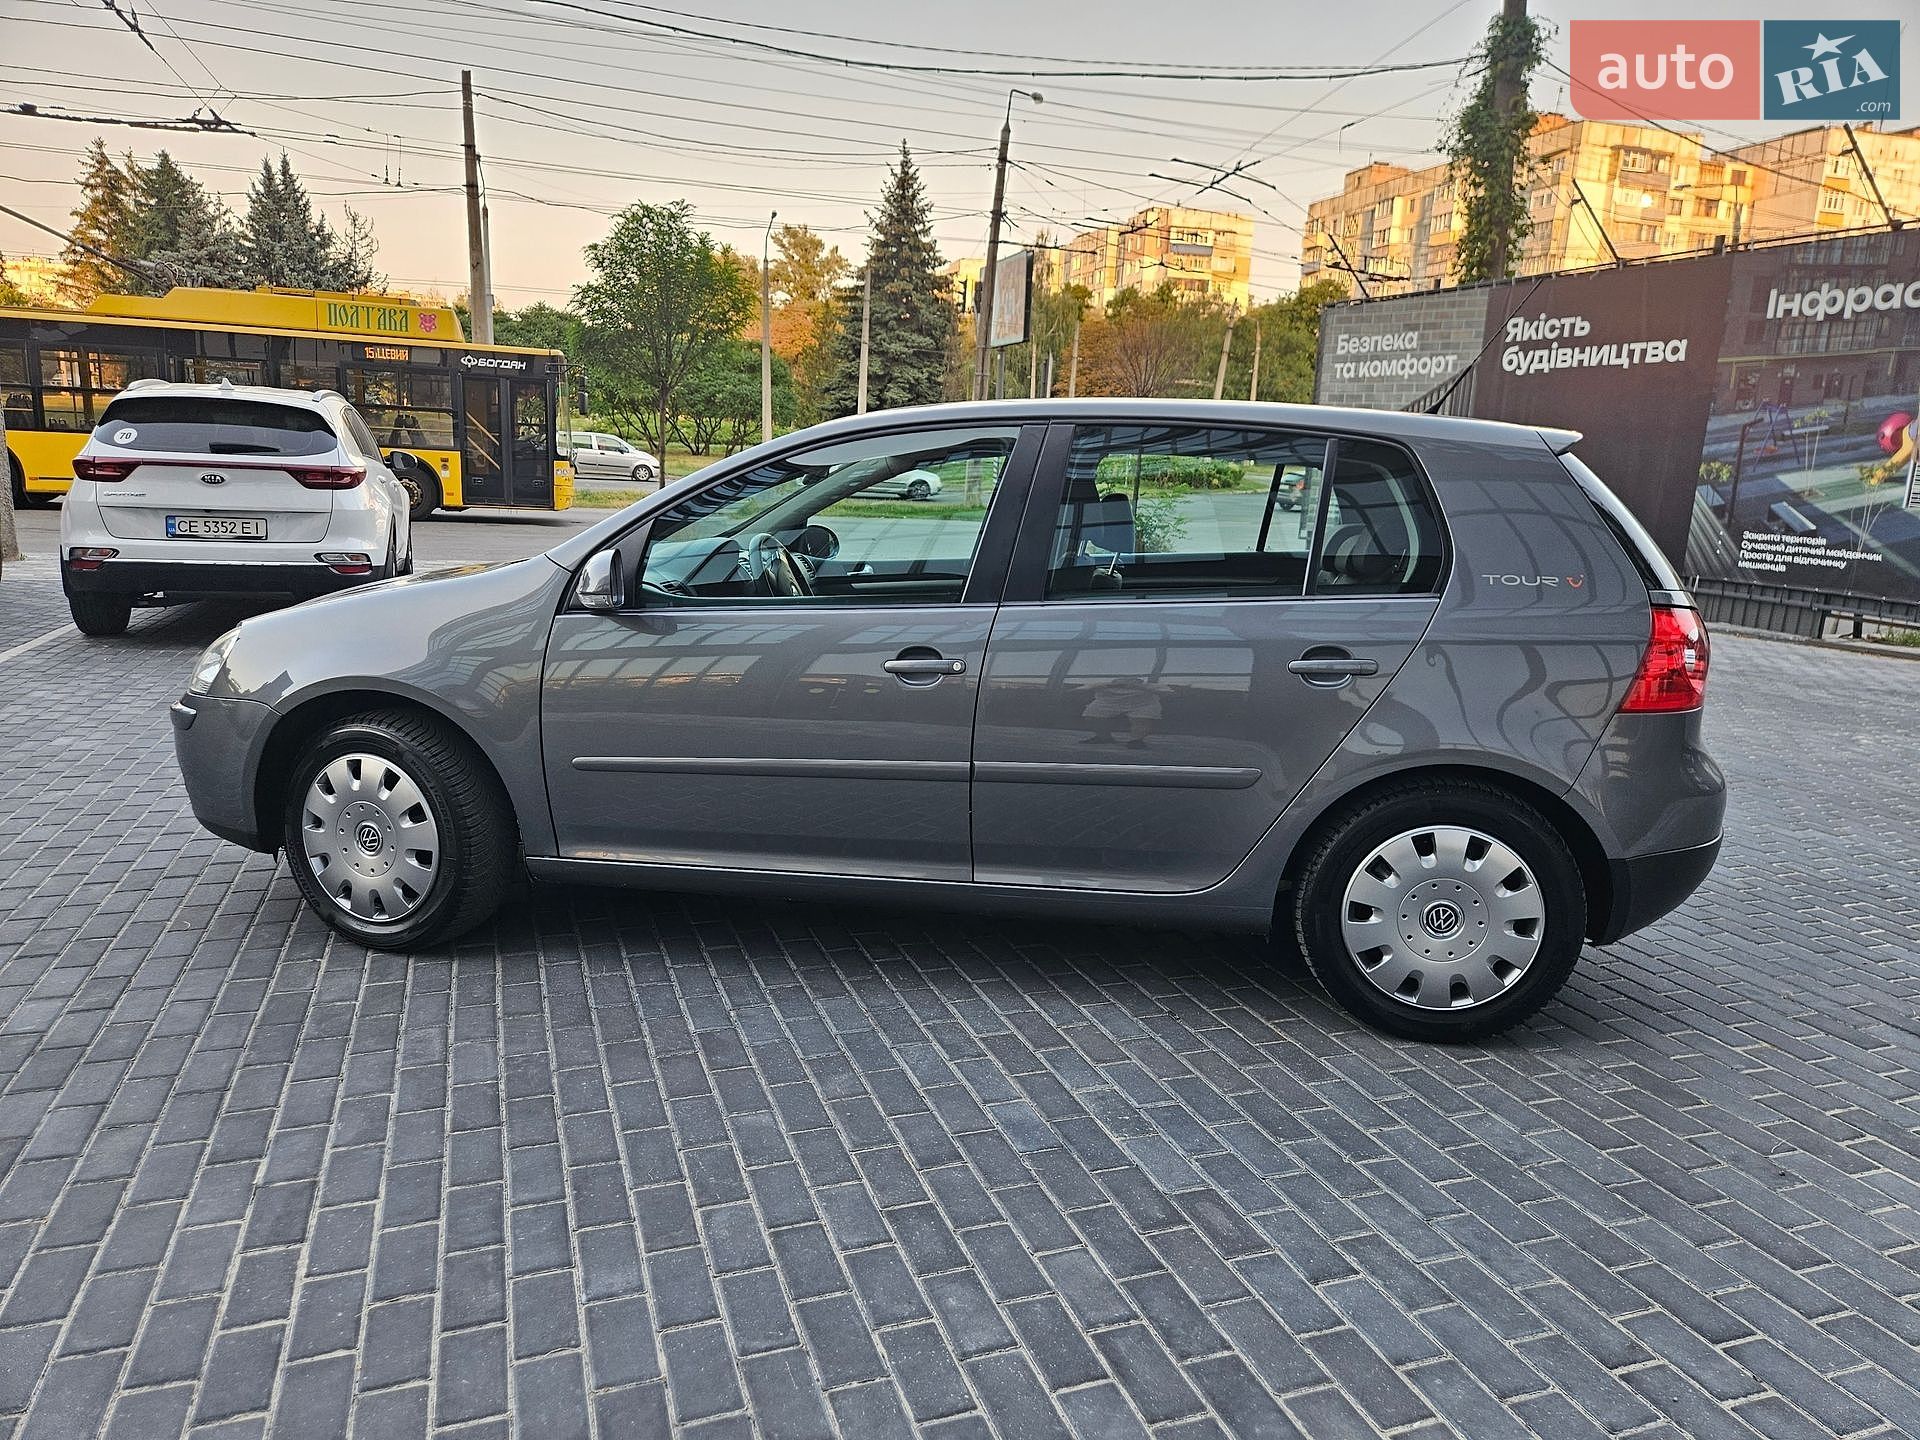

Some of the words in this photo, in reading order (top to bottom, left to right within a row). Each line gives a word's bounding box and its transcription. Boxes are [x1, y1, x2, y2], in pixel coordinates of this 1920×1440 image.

[327, 302, 410, 333] ПОЛТАВА
[1505, 313, 1591, 343] Якість
[1336, 329, 1419, 356] Безпека
[478, 358, 526, 370] БОГДАН
[1502, 338, 1688, 376] будівництва
[1334, 361, 1357, 379] та
[1358, 352, 1457, 380] комфорт
[119, 431, 132, 440] 70
[204, 474, 222, 484] KIA
[177, 520, 199, 533] CE
[203, 521, 237, 534] 5352
[1781, 534, 1827, 546] територія
[1739, 550, 1774, 563] Простір
[1774, 554, 1793, 564] для
[1793, 554, 1847, 570] відпочинку
[1741, 541, 1785, 552] Сучасний
[1785, 544, 1826, 557] дитячий
[1826, 548, 1882, 562] майданчик
[1737, 560, 1786, 573] мешканців
[1481, 574, 1559, 588] TOUR
